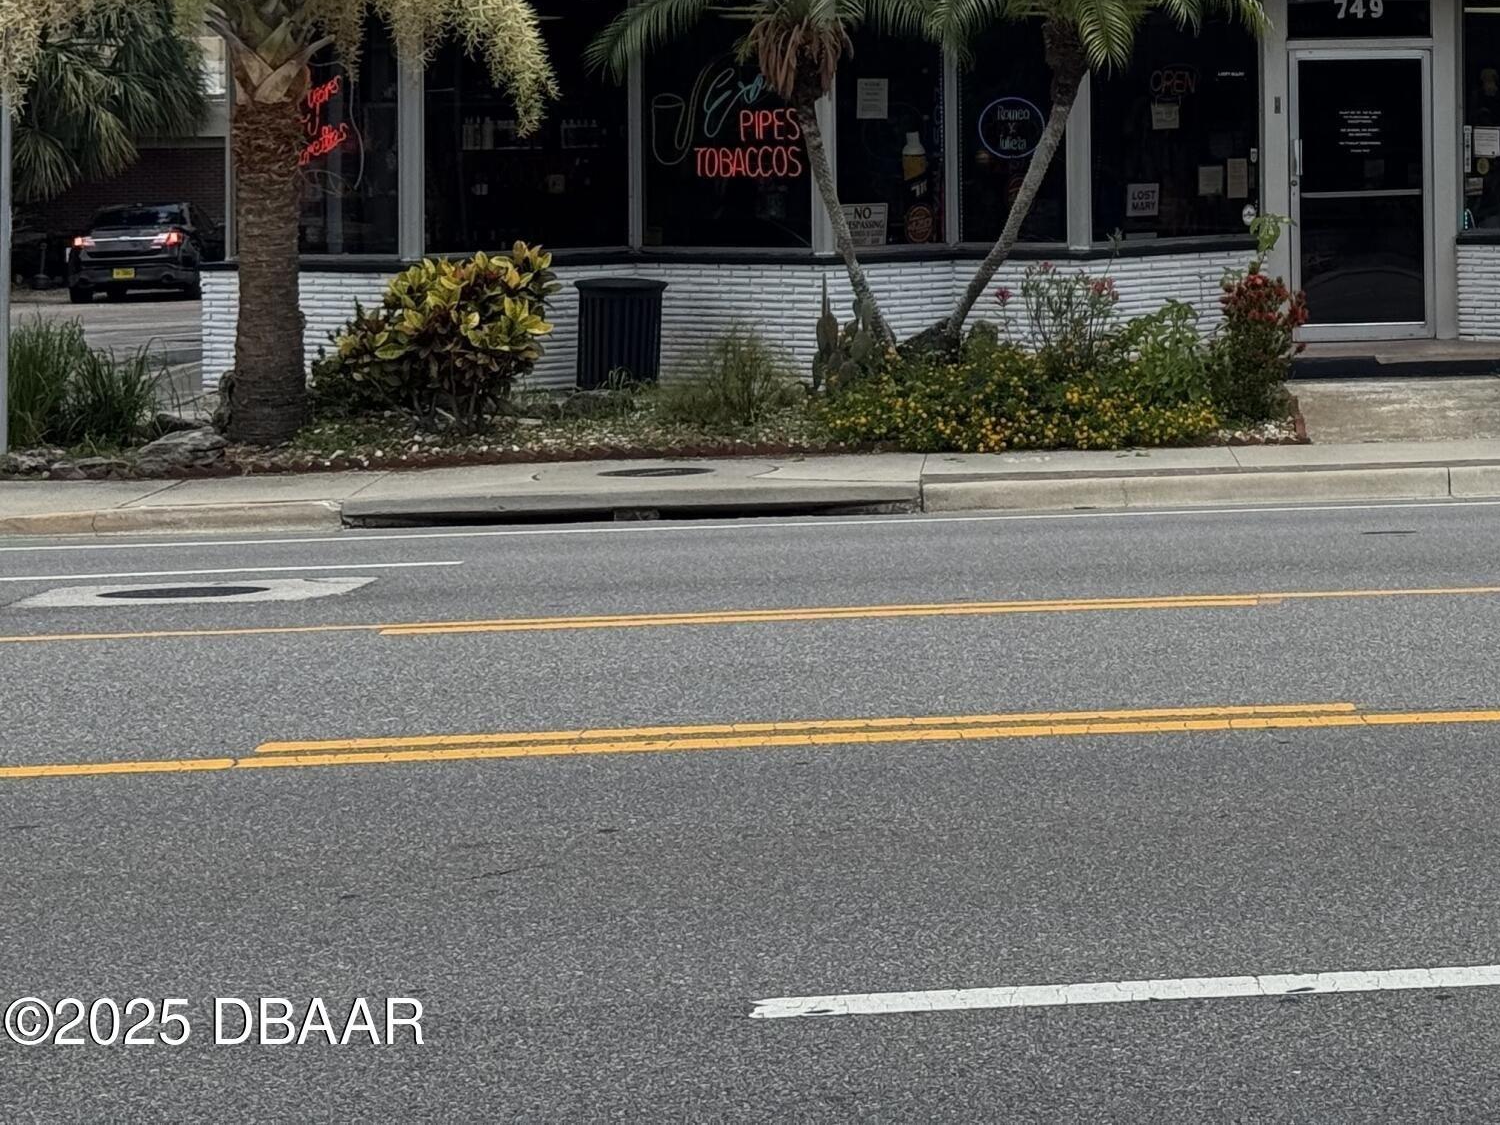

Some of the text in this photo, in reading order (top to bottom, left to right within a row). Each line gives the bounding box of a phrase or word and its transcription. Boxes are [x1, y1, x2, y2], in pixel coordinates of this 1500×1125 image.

[1150, 69, 1197, 94] OPEN
[739, 107, 801, 142] PIPES
[693, 145, 802, 178] TOBACCOS
[1132, 190, 1156, 200] LOST
[854, 207, 872, 219] NO
[1131, 201, 1156, 211] MARY
